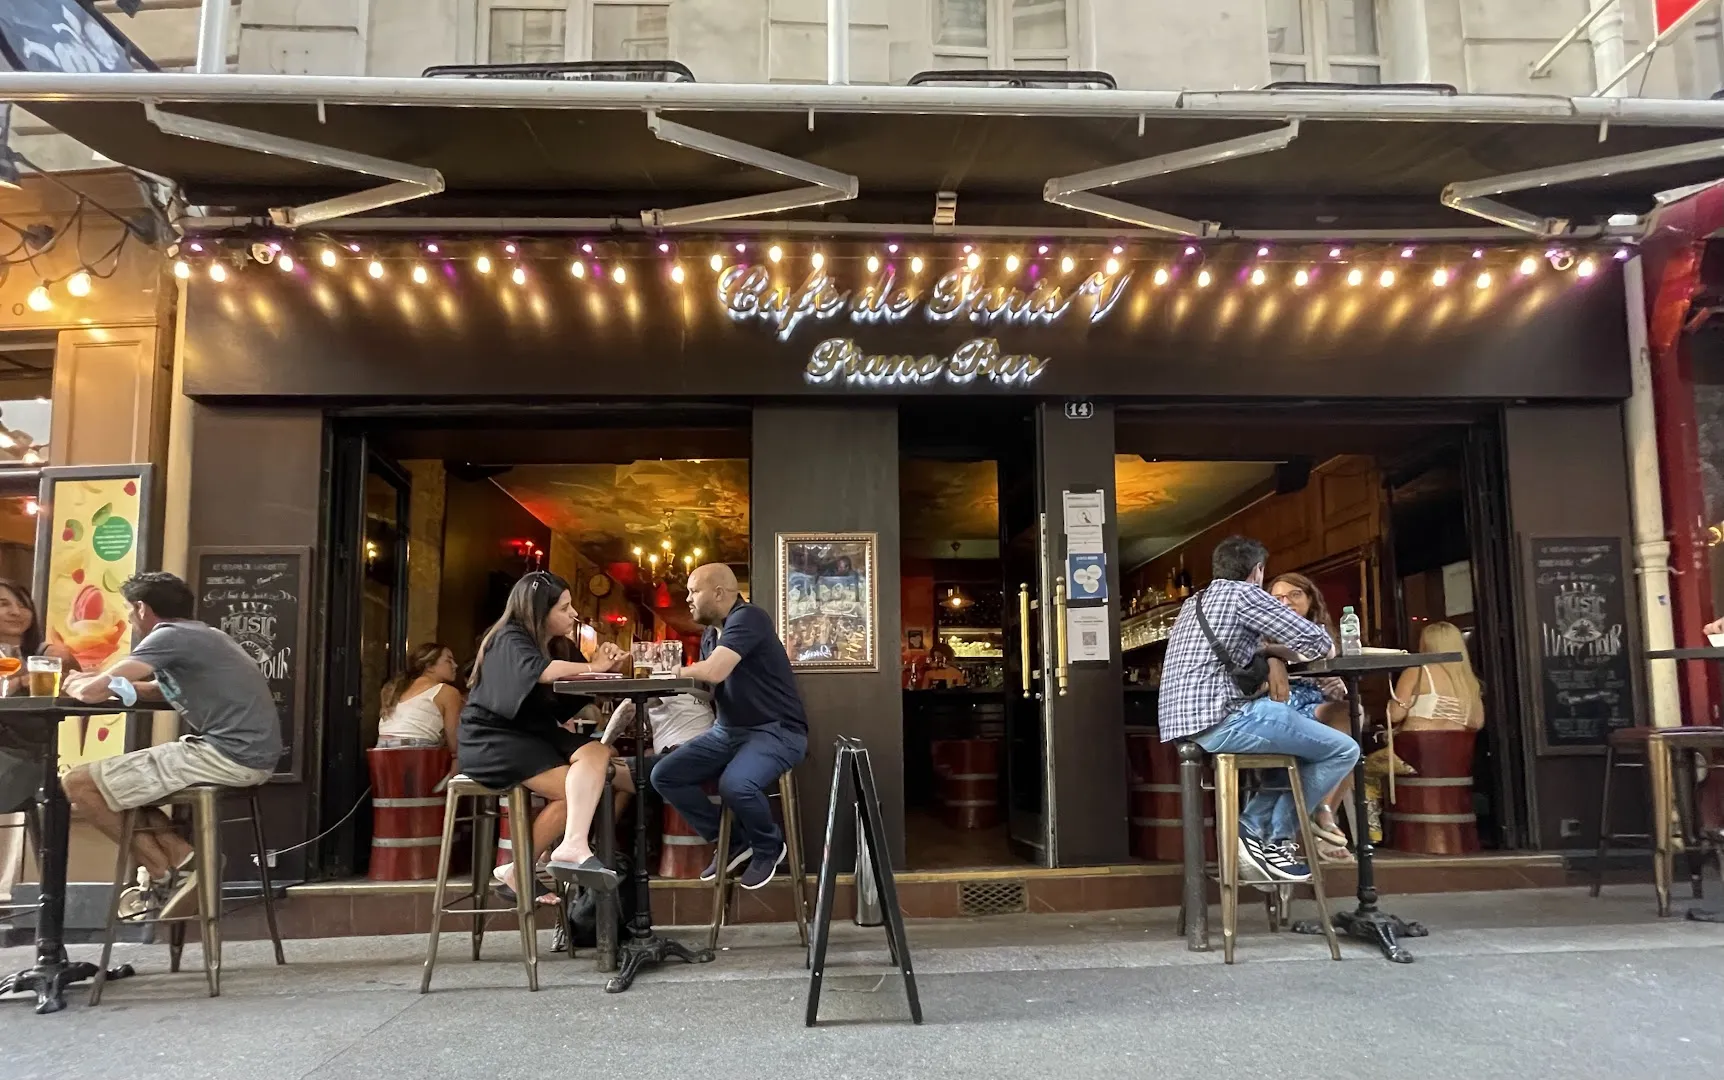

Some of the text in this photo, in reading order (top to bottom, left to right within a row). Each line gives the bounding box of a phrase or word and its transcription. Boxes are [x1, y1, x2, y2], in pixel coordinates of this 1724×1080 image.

[850, 267, 921, 322] de
[926, 266, 1071, 323] Paris
[804, 337, 1051, 384] Piano Bar
[1070, 403, 1088, 416] 14
[220, 614, 277, 640] MUSIC
